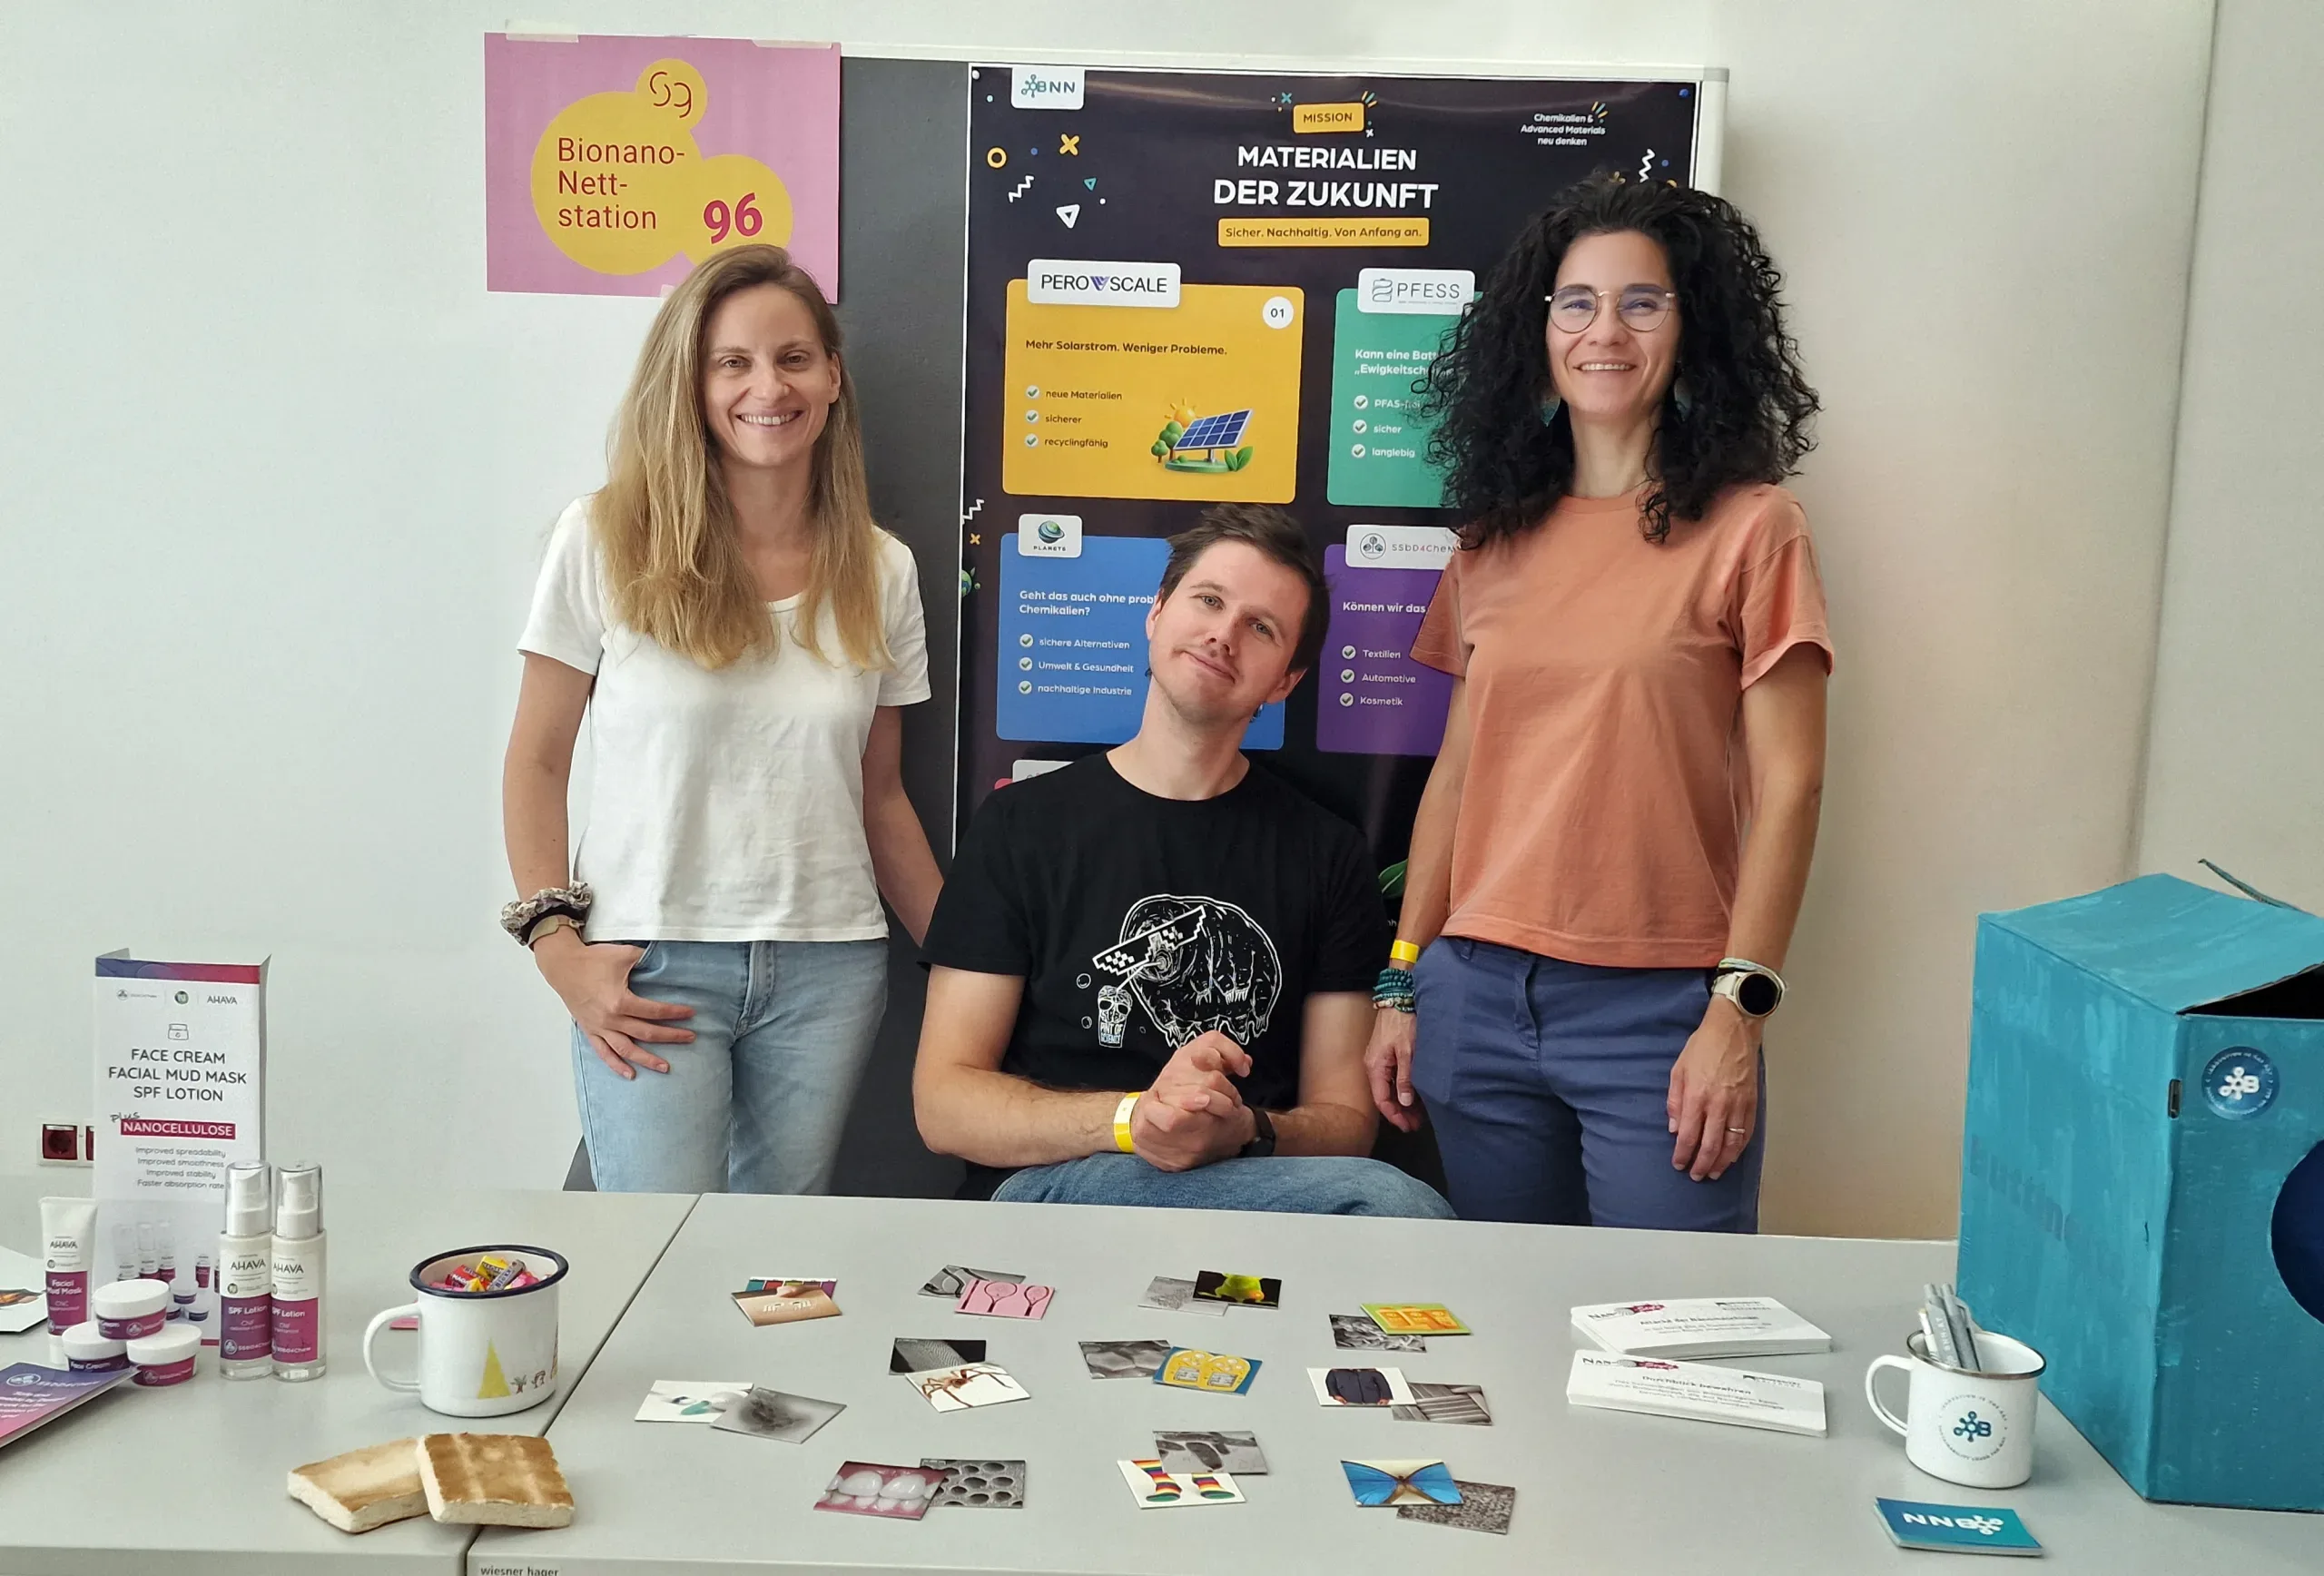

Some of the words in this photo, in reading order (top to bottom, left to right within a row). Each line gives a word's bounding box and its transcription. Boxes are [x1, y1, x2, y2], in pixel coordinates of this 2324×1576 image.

[1037, 80, 1076, 94] BNN
[1303, 113, 1353, 123] MISSION
[1533, 113, 1587, 123] Chemikalien
[1521, 124, 1564, 133] Advanced
[1565, 125, 1606, 135] Materials
[1555, 137, 1588, 145] denken
[556, 137, 685, 165] Bionano-
[1237, 146, 1417, 171] MATERIALIEN
[556, 170, 628, 196] Nett-
[1213, 179, 1279, 205] DER
[1285, 181, 1440, 209] ZUKUNFT
[556, 204, 657, 230] station
[703, 192, 763, 244] 96
[1226, 227, 1265, 238] Sicher.
[1266, 228, 1332, 241] Nachhaltig.
[1334, 228, 1357, 238] Von
[1359, 228, 1401, 240] Anfang
[1403, 230, 1423, 238] an.
[1397, 283, 1461, 299] PFESS
[1270, 308, 1285, 319] 01
[1025, 340, 1053, 350] Mehr
[1056, 340, 1120, 352] Solarstrom.
[1122, 342, 1168, 355] Weniger
[1170, 344, 1227, 356] Probleme.
[1354, 349, 1384, 360] Kann
[1386, 350, 1410, 360] eine
[1045, 391, 1069, 399] neue
[1070, 391, 1123, 401] Materialien
[1045, 414, 1082, 424] sicherer
[1373, 425, 1402, 434] sicher
[1044, 438, 1108, 449] recyclingfähig
[1372, 448, 1416, 458] langlebig
[1019, 590, 1046, 601] Geht
[1049, 591, 1068, 602] das
[1070, 592, 1097, 603] auch
[1099, 593, 1127, 604] ohne
[1019, 605, 1091, 616] Chemikalien?
[1343, 602, 1385, 613] Können
[1386, 603, 1403, 613] wir
[1405, 604, 1426, 614] das
[1039, 638, 1072, 647] sichere
[1074, 639, 1130, 649] Alternativen
[1363, 649, 1401, 659] Textilien
[1038, 662, 1073, 672] Umwelt
[1074, 663, 1080, 672] &
[1082, 664, 1134, 674] Gesundheit
[1362, 674, 1416, 685] Automotive
[1038, 685, 1091, 695] nachhaltige
[1092, 686, 1132, 696] Industrie
[1360, 696, 1403, 706] Kosmetik
[207, 995, 238, 1005] AHAVA
[131, 1049, 169, 1062] FACE
[173, 1050, 225, 1064] CREAM
[108, 1067, 161, 1080] FACIAL
[165, 1069, 202, 1082] MUD
[205, 1071, 247, 1085] MASK
[133, 1086, 162, 1099] SPF
[166, 1088, 224, 1102] LOTION
[123, 1122, 233, 1137] NANOCELLULOSE
[135, 1146, 174, 1157] Improved
[175, 1147, 226, 1158] spreadability
[137, 1157, 176, 1167] Improved
[177, 1158, 225, 1168] smoothness
[146, 1168, 184, 1179] Improved
[185, 1169, 217, 1180] stability
[137, 1178, 162, 1187] Faster
[163, 1178, 207, 1190] absorption
[208, 1181, 225, 1190] rate
[49, 1240, 78, 1249] AHAVA
[231, 1258, 267, 1271] AHAVA
[273, 1263, 304, 1274] AHAVA
[51, 1279, 74, 1287] Facial
[228, 1306, 243, 1315] SPF
[244, 1305, 268, 1315] Lotion
[281, 1310, 306, 1318] Lotion
[480, 1565, 524, 1576] wiesner
[527, 1566, 559, 1576] hager
